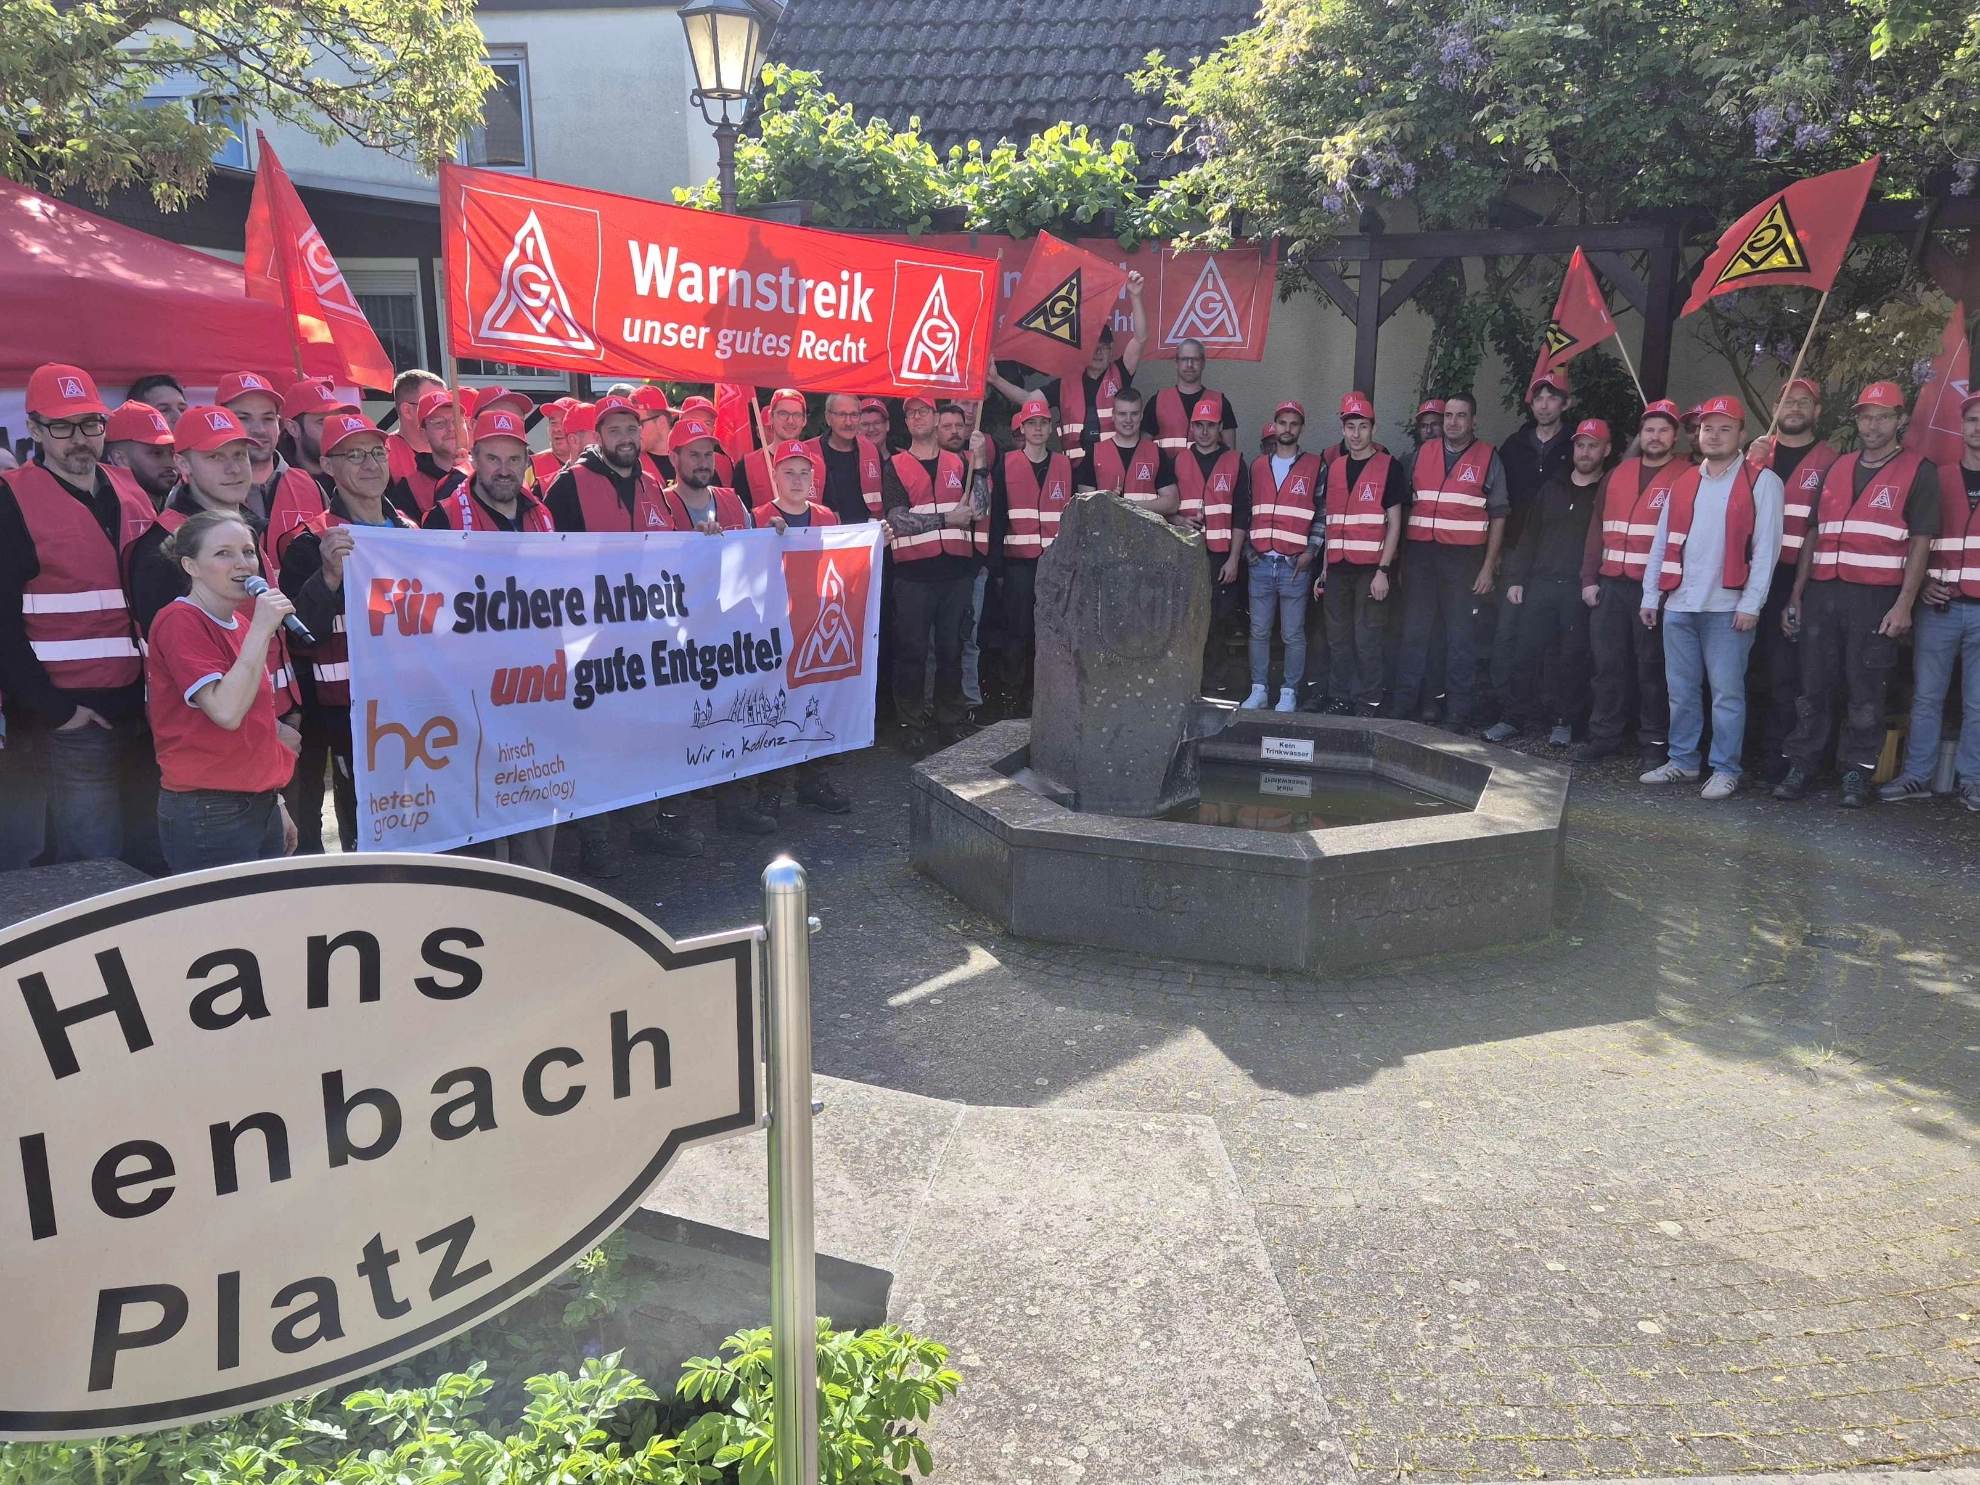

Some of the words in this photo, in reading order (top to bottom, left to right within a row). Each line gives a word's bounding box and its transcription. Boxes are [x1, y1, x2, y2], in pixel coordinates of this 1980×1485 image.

[627, 239, 875, 323] Warnstreik
[622, 316, 711, 350] unser
[714, 326, 792, 361] gutes
[797, 329, 869, 363] Recht
[368, 577, 444, 637] Für
[451, 574, 587, 634] sichere
[593, 569, 690, 625] Arbeit
[490, 648, 568, 707] und
[572, 646, 647, 710] gute
[651, 627, 783, 691] Entgelte!
[366, 699, 459, 772] he
[498, 736, 535, 763] hirsch
[1279, 741, 1296, 749] Kein
[721, 747, 736, 759] in
[1265, 747, 1310, 758] Trinkwasser
[494, 754, 565, 785] erlenbach
[370, 783, 436, 816] hetech
[495, 778, 576, 808] technology
[373, 811, 429, 843] group
[16, 925, 486, 1081] Hans
[87, 1214, 494, 1393] Platz
